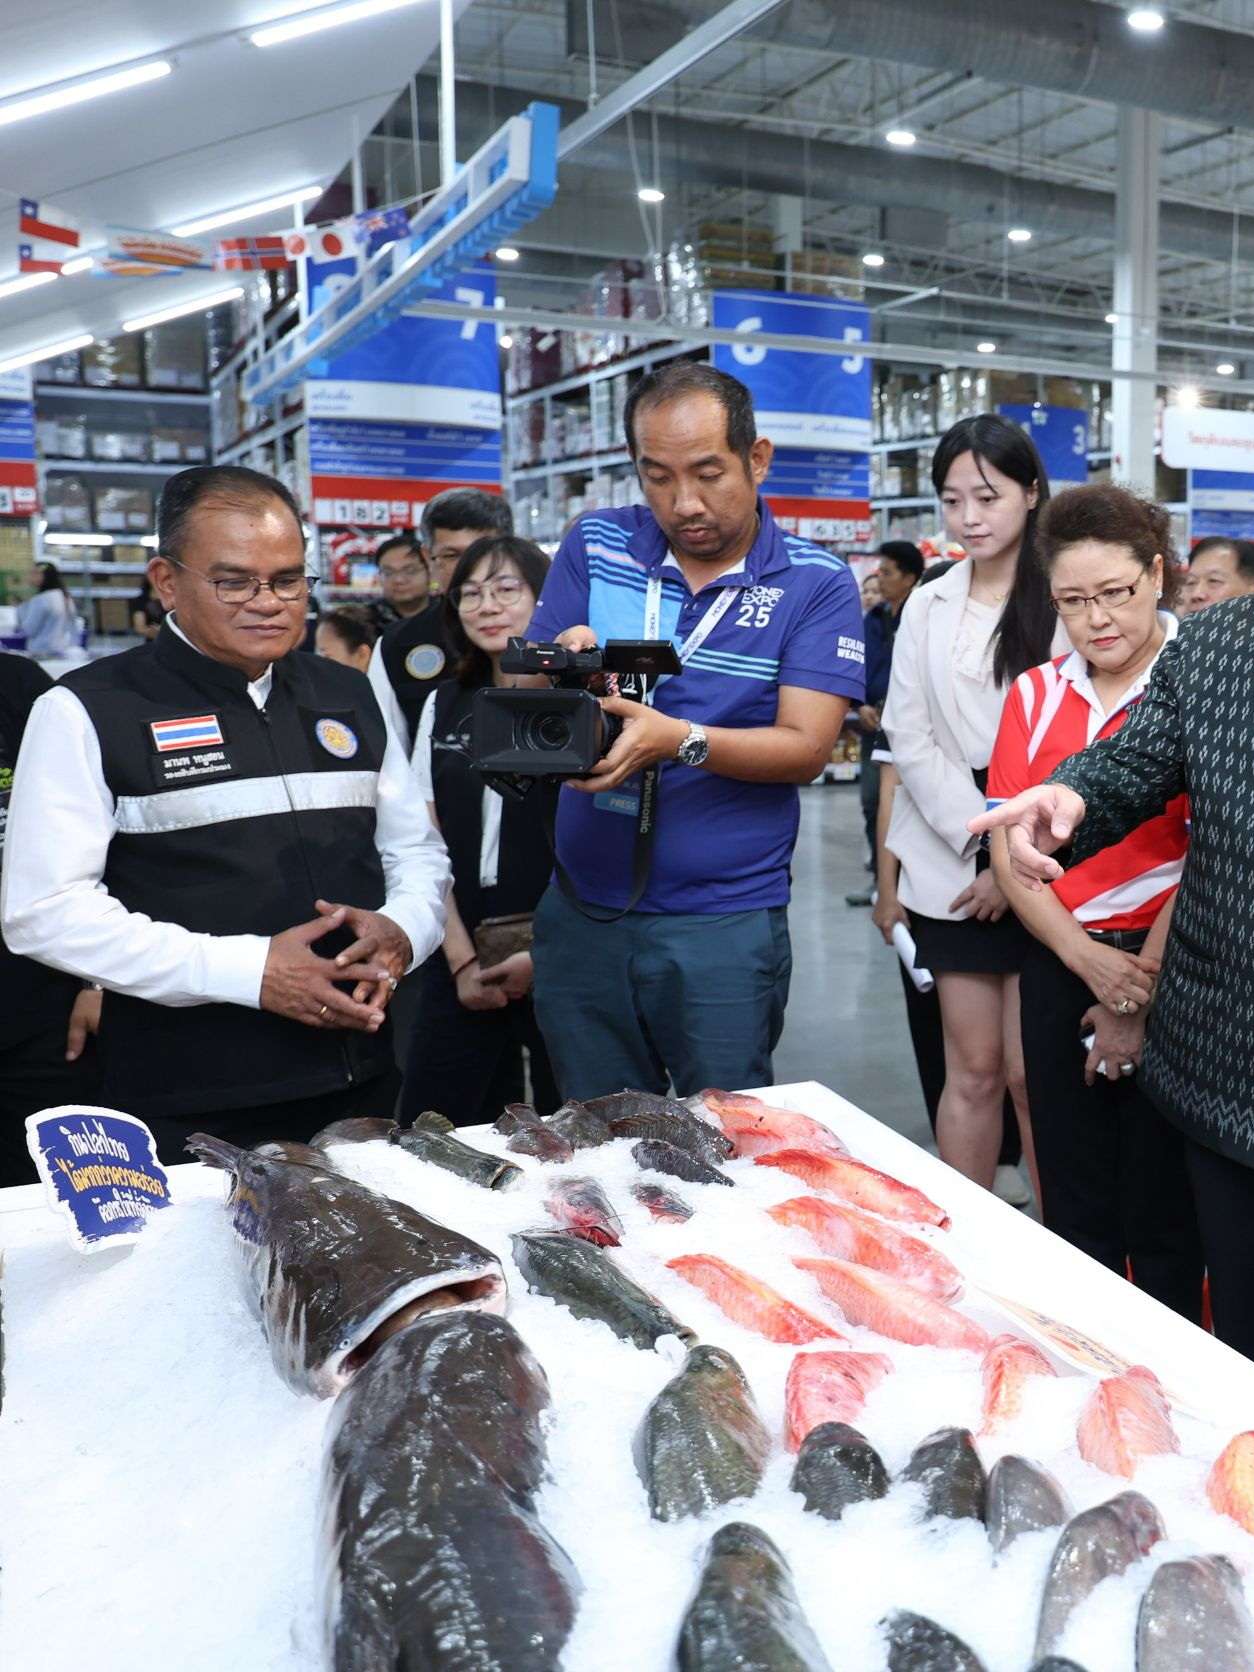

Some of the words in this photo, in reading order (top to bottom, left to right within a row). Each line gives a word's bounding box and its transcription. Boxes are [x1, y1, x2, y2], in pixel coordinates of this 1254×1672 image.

[455, 286, 485, 340] 7
[731, 316, 768, 366] 6
[840, 327, 864, 375] 5
[1072, 423, 1086, 454] 3
[735, 604, 772, 629] 25
[640, 770, 656, 833] Panasonic
[59, 1118, 130, 1162] กินปลาไทย
[55, 1155, 165, 1198] ได้มากกว่าความอร่อย
